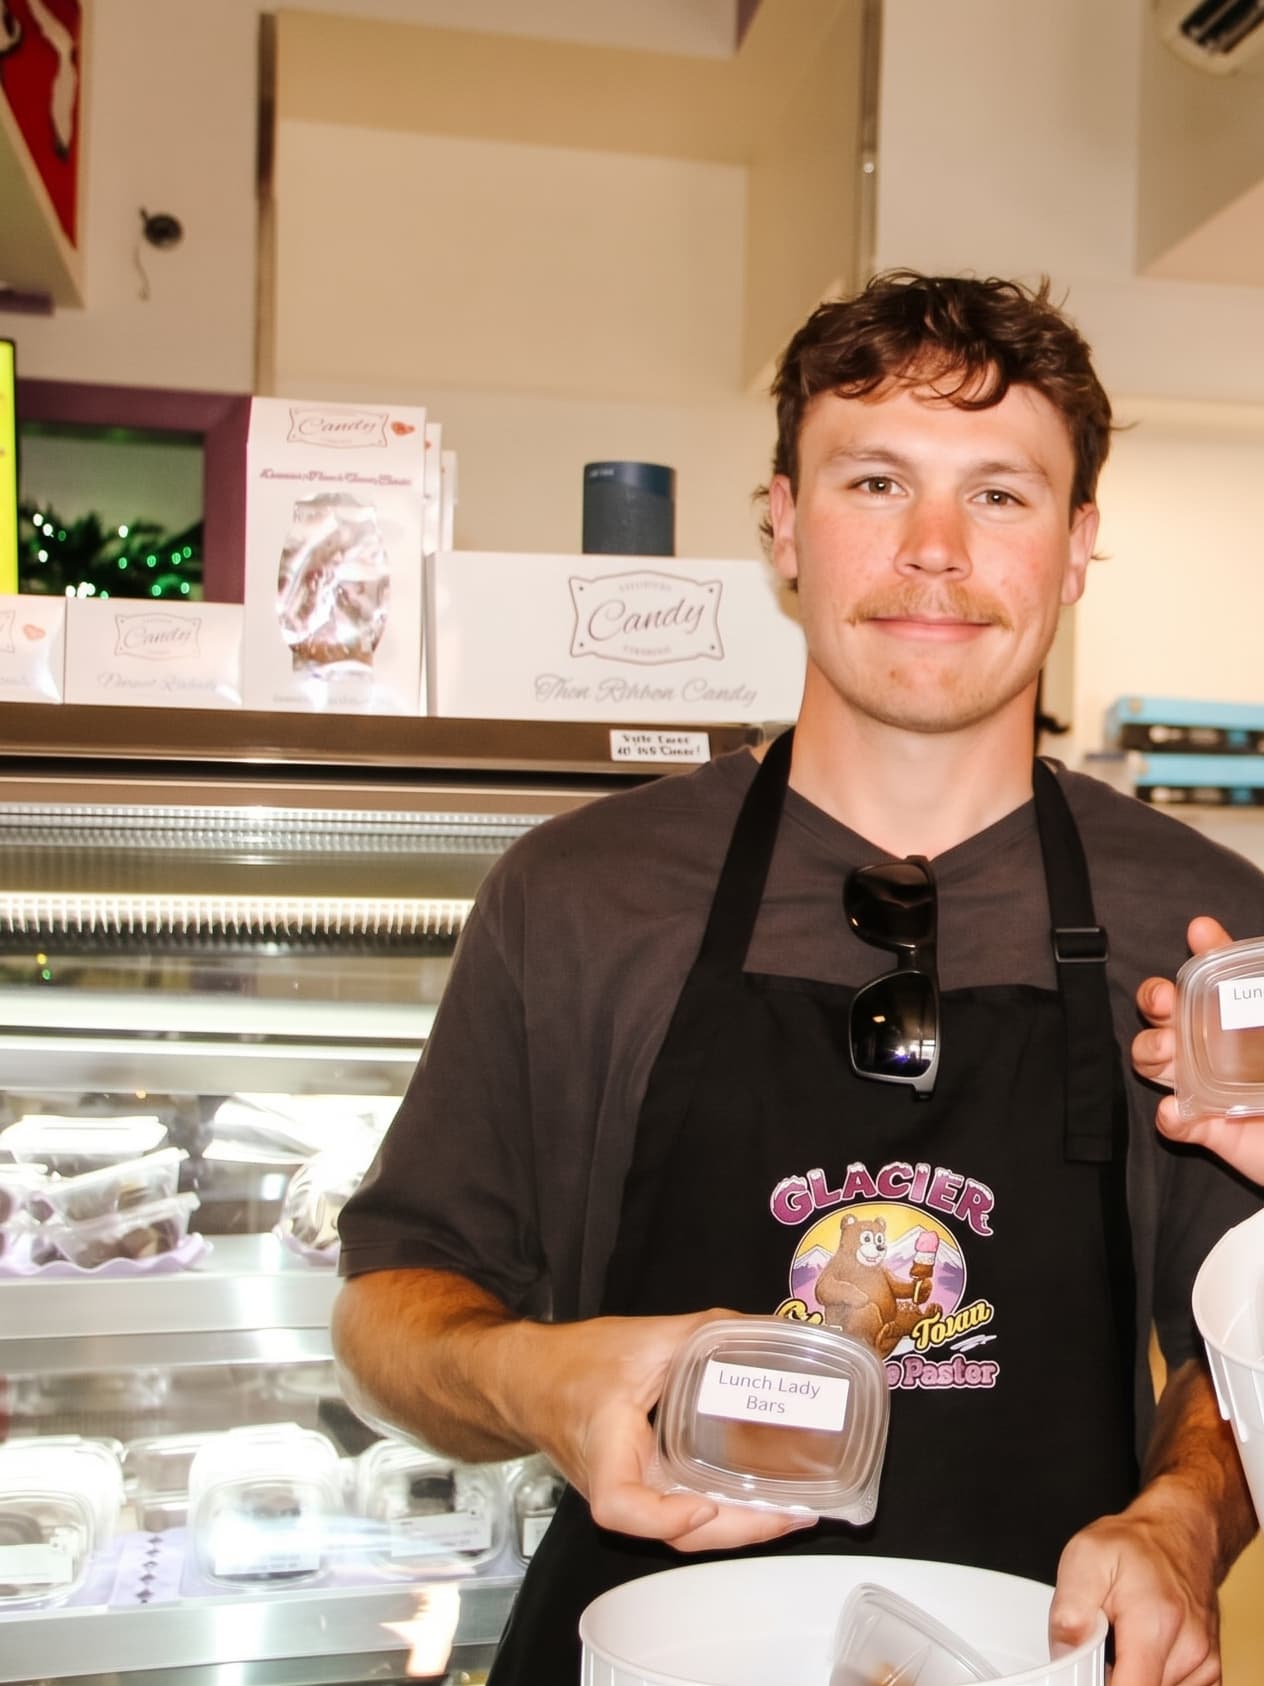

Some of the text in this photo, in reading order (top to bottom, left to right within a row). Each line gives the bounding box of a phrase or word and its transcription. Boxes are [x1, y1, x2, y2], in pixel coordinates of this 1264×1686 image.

[298, 416, 377, 435] Candy
[588, 598, 705, 642] Candy
[681, 678, 758, 708] Candy
[769, 1161, 995, 1237] GLACIER
[911, 1299, 995, 1353] Town
[718, 1369, 821, 1398] Lunch Lady
[746, 1395, 786, 1414] Bars
